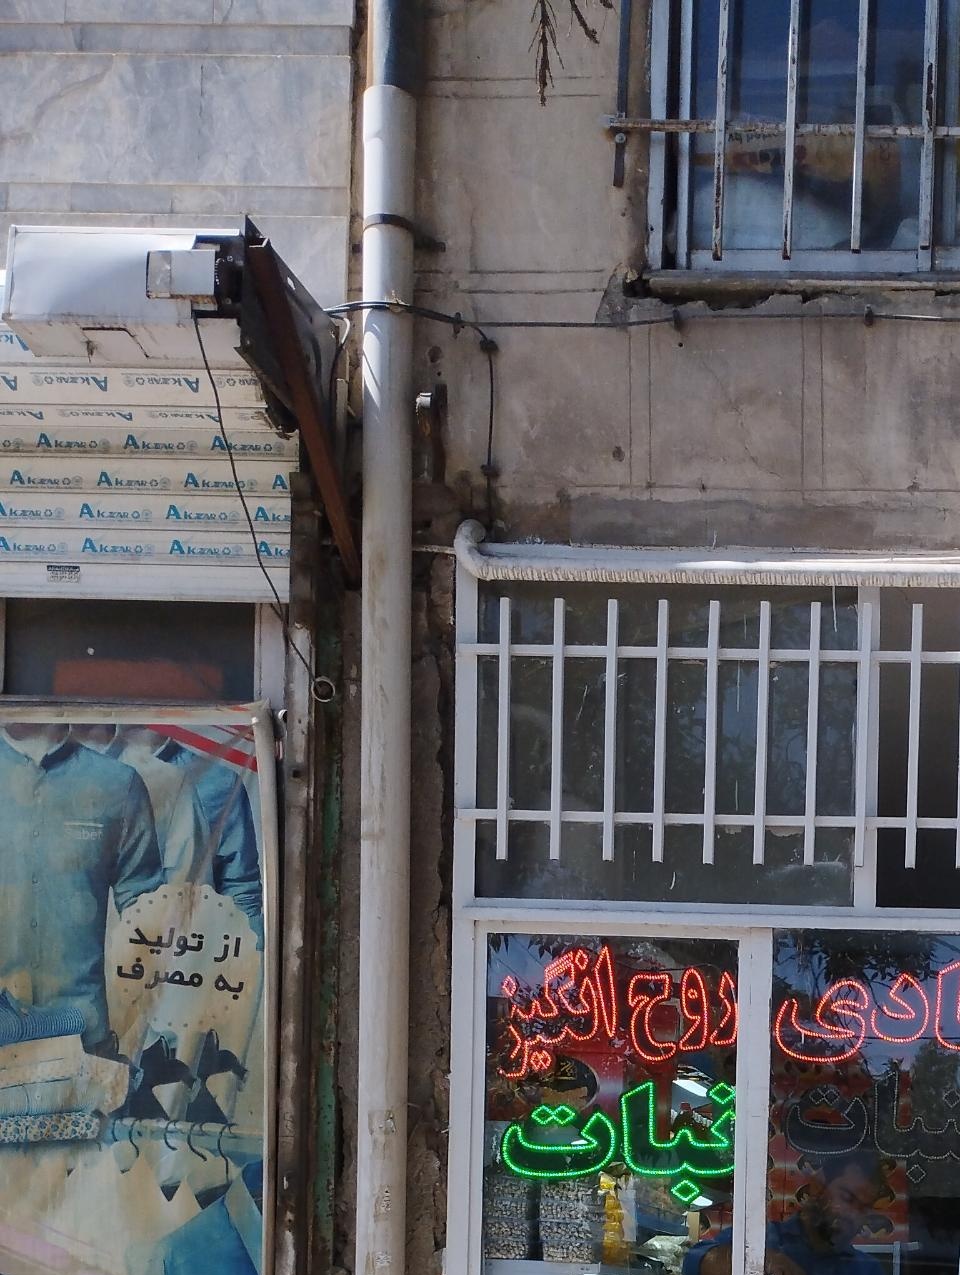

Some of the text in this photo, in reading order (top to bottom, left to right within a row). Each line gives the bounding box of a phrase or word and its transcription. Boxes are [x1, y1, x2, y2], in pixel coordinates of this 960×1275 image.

[117, 957, 244, 1000] به مصرف
[129, 927, 241, 962] از تولید
[497, 944, 617, 1077] انگیز
[628, 966, 739, 1061] روح
[502, 1080, 737, 1204] نبات
